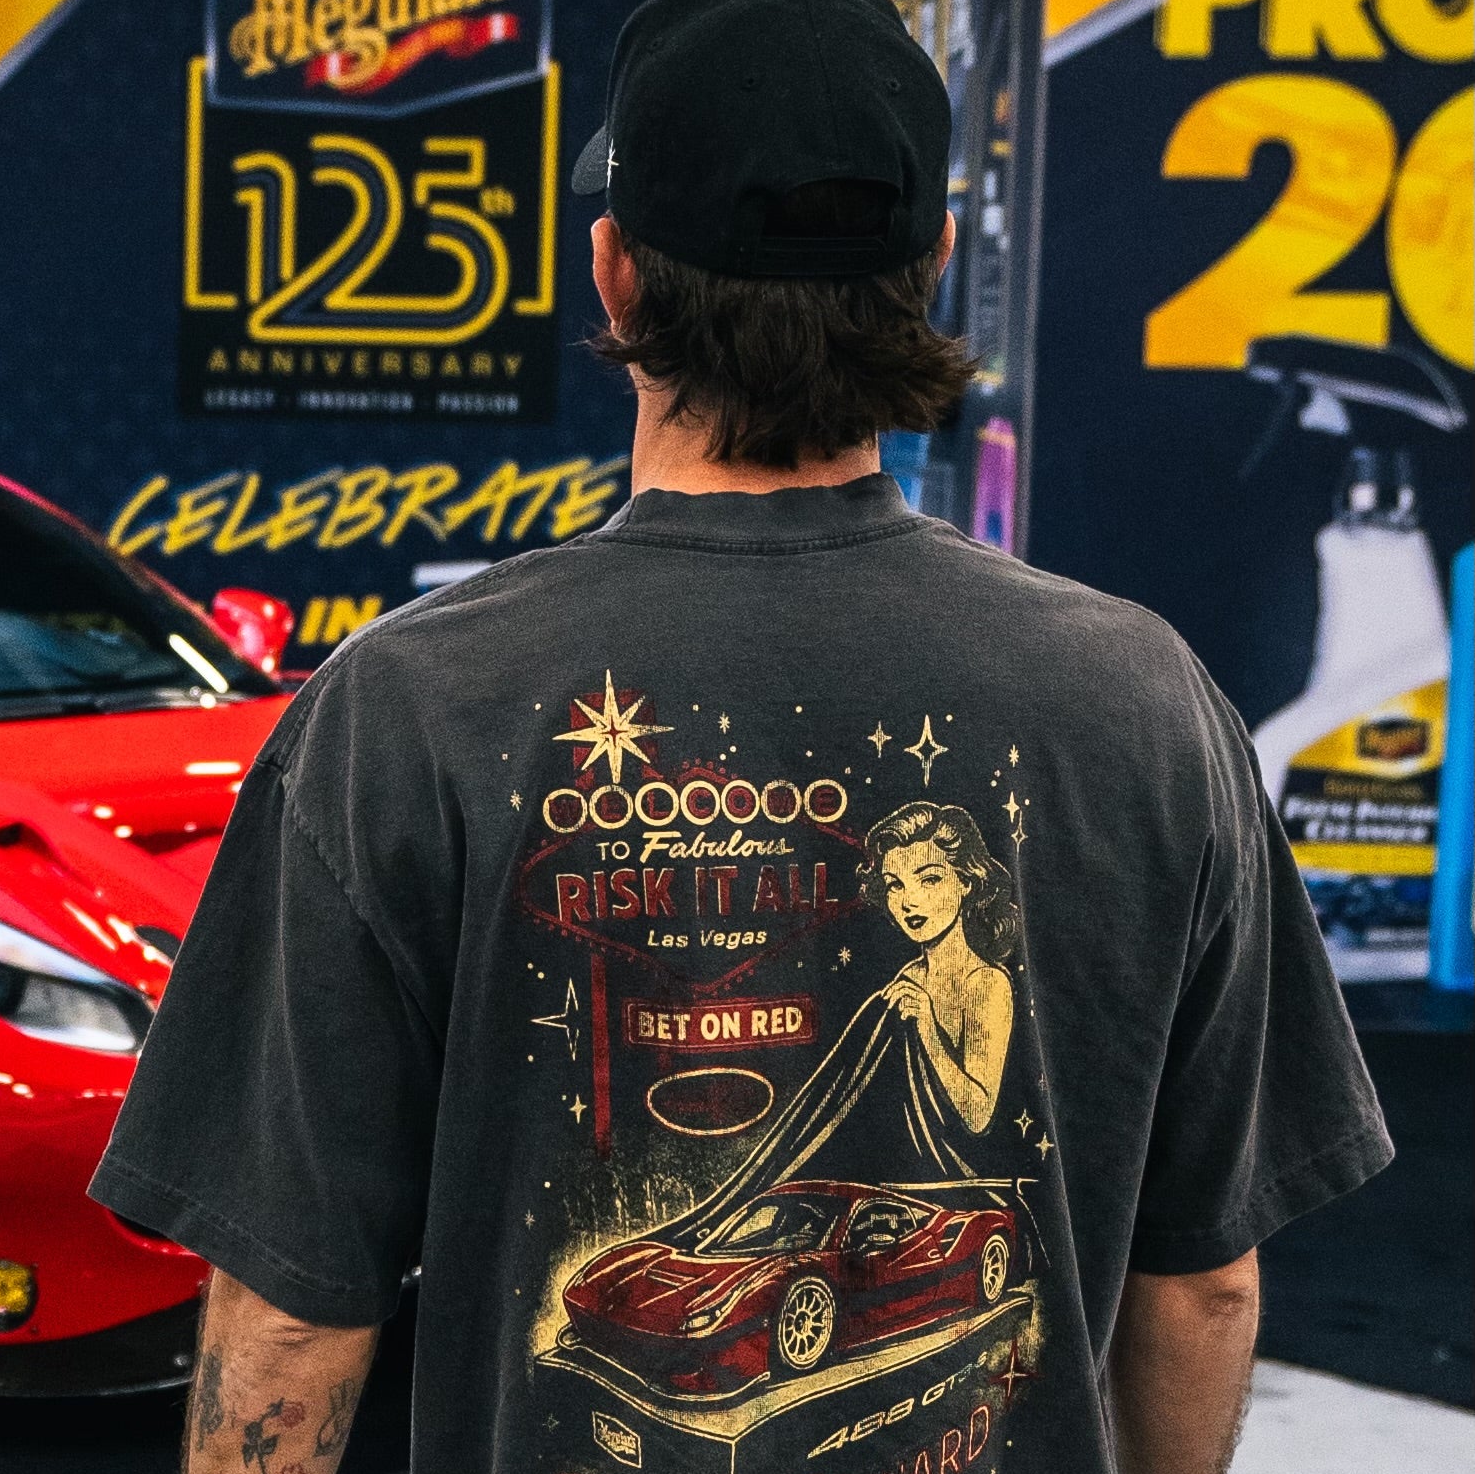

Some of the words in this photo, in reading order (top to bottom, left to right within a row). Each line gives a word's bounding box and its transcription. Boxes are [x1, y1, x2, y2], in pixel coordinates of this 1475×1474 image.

[207, 348, 523, 376] ANNIVERSARY
[109, 458, 632, 559] CELEBRATE
[543, 779, 848, 834] WELCOME
[596, 841, 631, 861] TO
[639, 829, 795, 864] Fabulous
[556, 867, 676, 923] RISK
[695, 866, 739, 916] IT
[753, 862, 839, 913] ALL
[647, 929, 689, 948] Las
[700, 929, 767, 950] Vegas
[638, 1011, 691, 1042] BET
[700, 1012, 741, 1041] ON
[751, 1006, 803, 1038] RED
